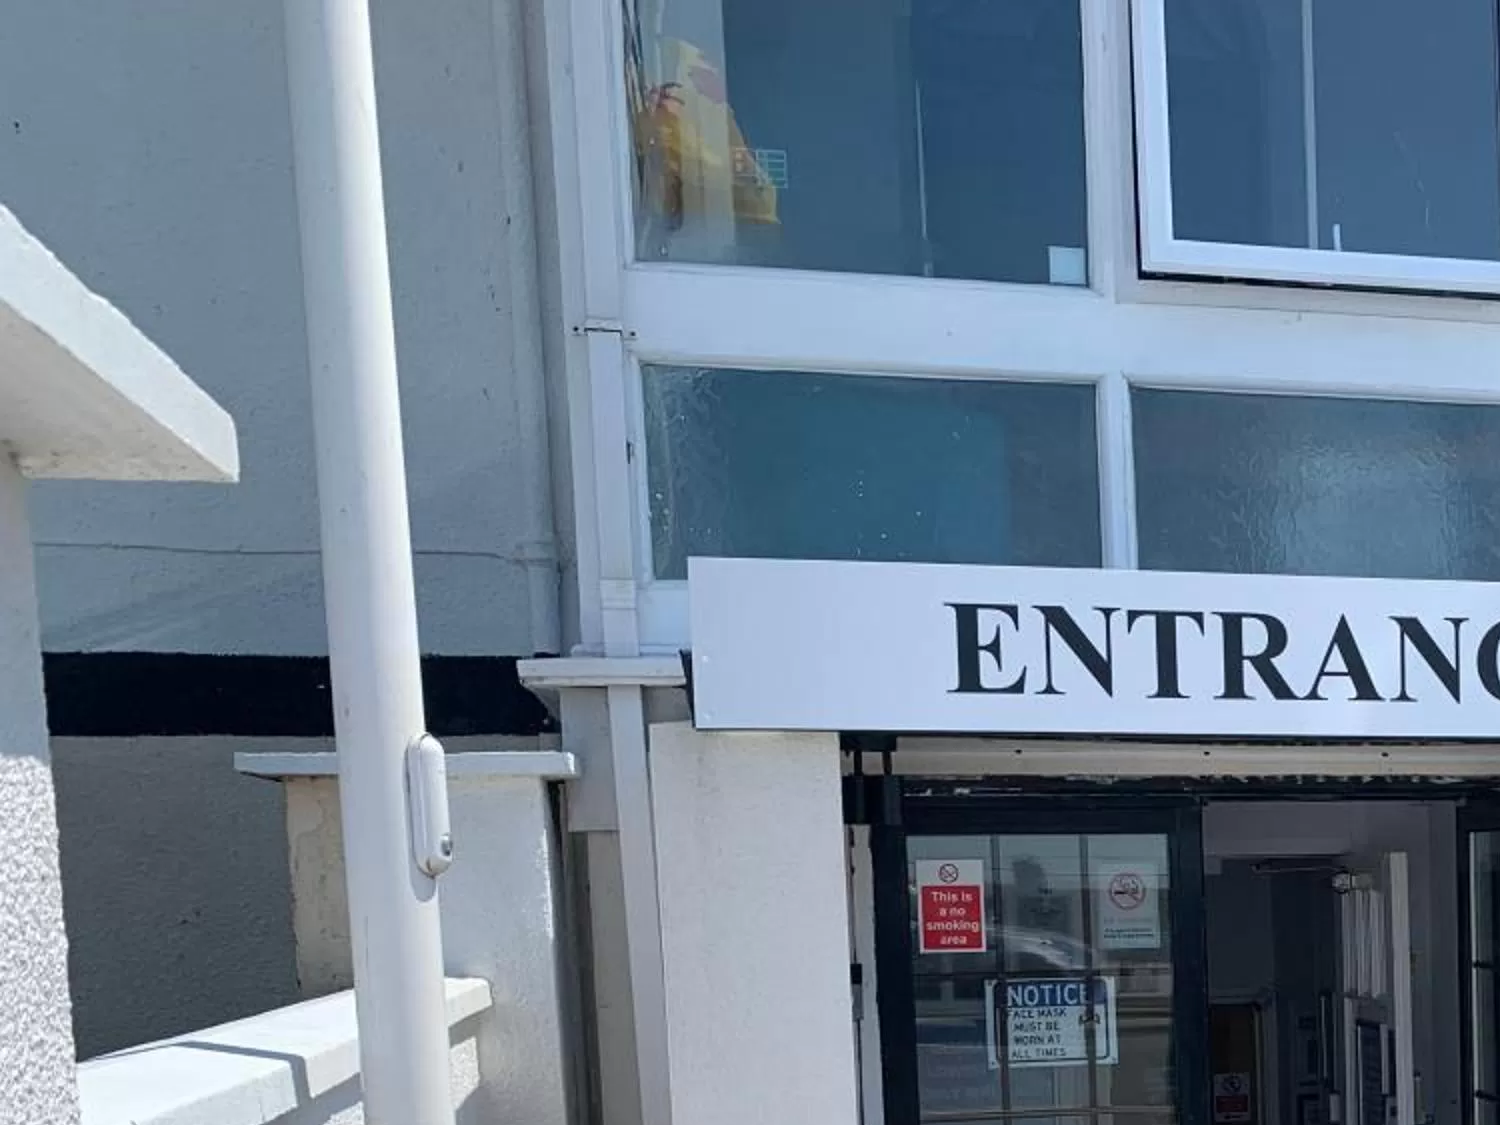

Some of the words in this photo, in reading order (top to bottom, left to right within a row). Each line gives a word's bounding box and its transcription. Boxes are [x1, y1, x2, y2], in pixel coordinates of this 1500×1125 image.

[931, 891, 958, 902] This
[961, 890, 973, 902] is
[939, 907, 947, 917] a
[949, 907, 966, 917] no
[926, 920, 980, 933] smoking
[940, 935, 968, 945] area
[1038, 1007, 1067, 1018] MASK
[1013, 1021, 1042, 1032] MUST
[1013, 1034, 1044, 1046] WORN
[1047, 1034, 1061, 1044] AT
[1035, 1047, 1067, 1057] TIMES
